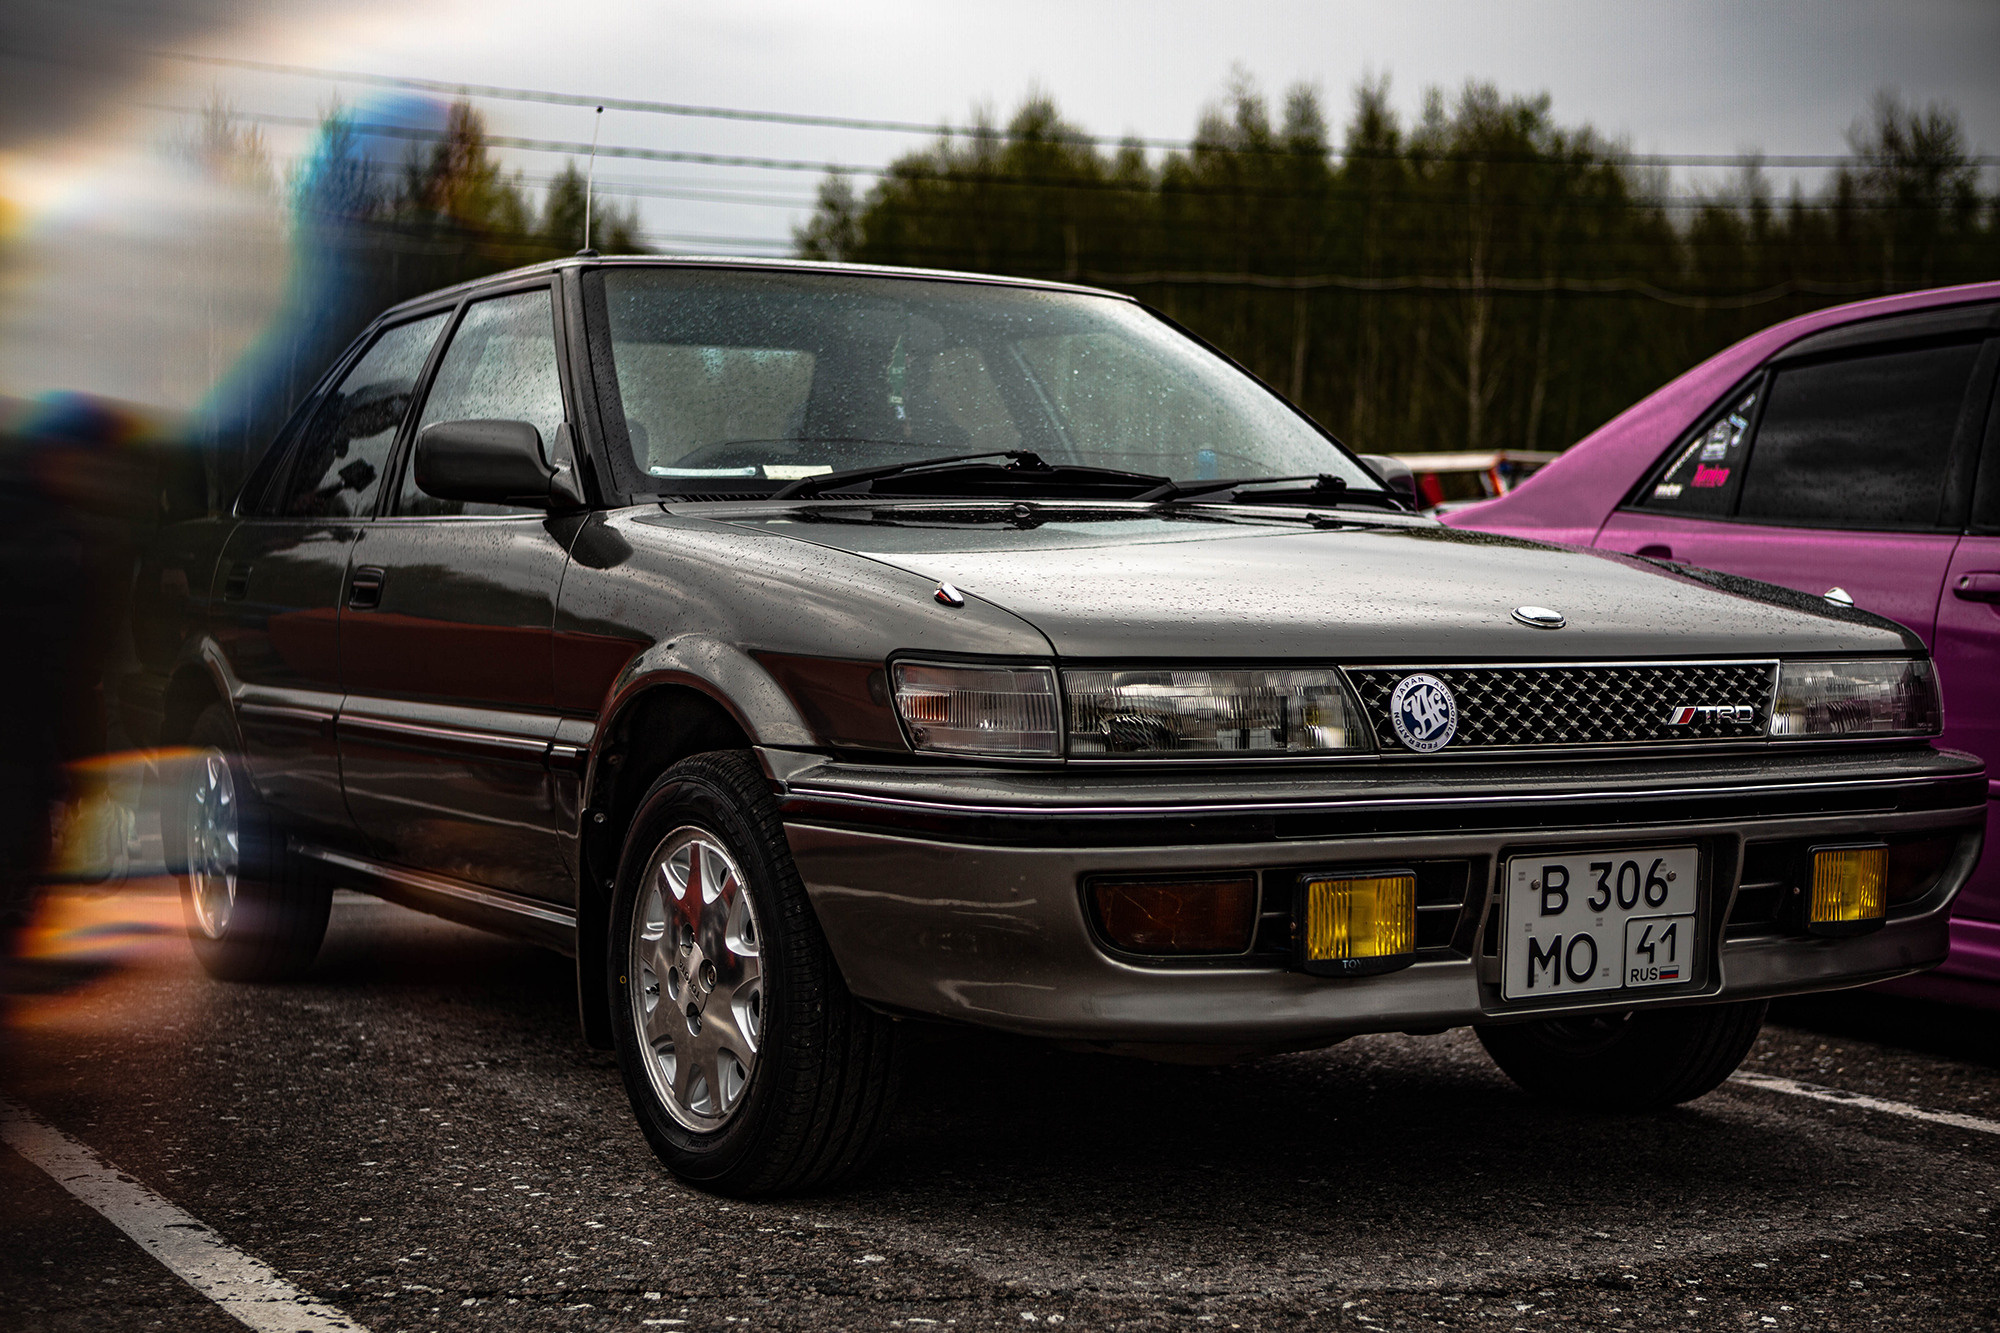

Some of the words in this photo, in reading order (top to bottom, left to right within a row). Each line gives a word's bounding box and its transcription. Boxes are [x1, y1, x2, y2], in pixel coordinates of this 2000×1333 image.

[1396, 676, 1425, 700] JAPAN
[1434, 681, 1456, 738] AUTOMOBILE
[1697, 706, 1754, 725] TRD
[1394, 711, 1439, 750] FEDERATION
[1587, 858, 1669, 913] 306
[1636, 922, 1677, 964] 41
[1630, 967, 1658, 982] RUS
